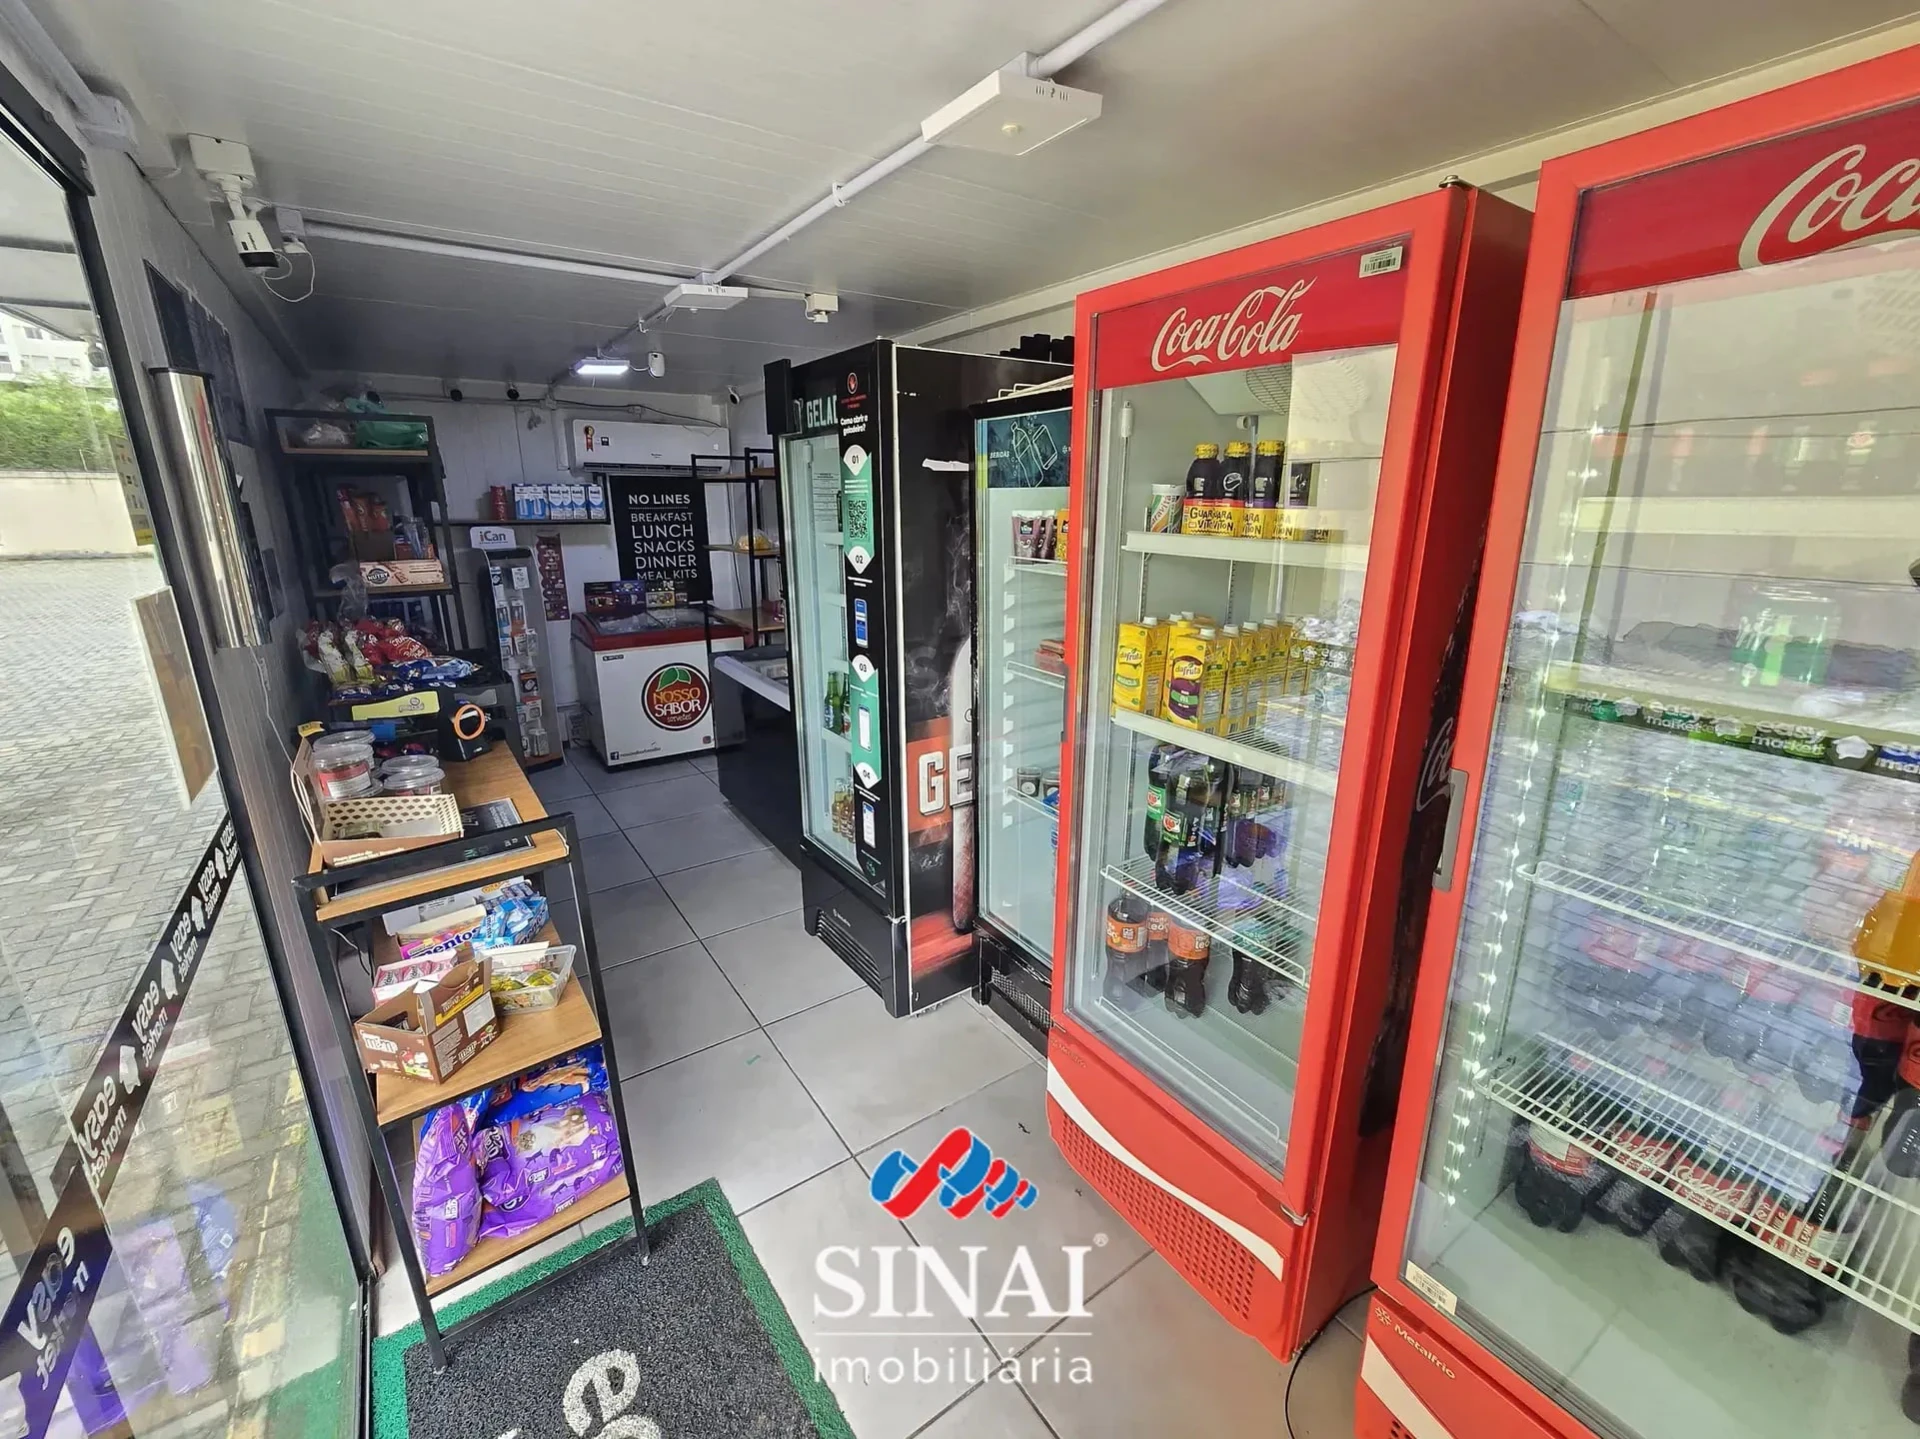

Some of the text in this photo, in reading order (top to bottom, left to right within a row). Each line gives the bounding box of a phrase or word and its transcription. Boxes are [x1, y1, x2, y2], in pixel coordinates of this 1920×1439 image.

[1152, 276, 1317, 372] Coca-Cola
[851, 455, 859, 464] 01
[628, 494, 691, 505] NO LINES
[631, 512, 693, 523] BREAKFAST
[479, 530, 506, 541] iCan
[632, 524, 694, 539] LUNCH
[634, 540, 695, 554] SNACKS
[635, 555, 697, 570] DINNER
[855, 554, 864, 564] 02
[367, 571, 389, 582] NUTRY
[637, 569, 698, 581] MEAL KITS
[859, 663, 867, 673] 03
[1175, 663, 1201, 677] dafruta
[653, 687, 701, 705] NOSSO
[655, 700, 702, 717] SABOR
[862, 769, 871, 780] 04
[1394, 1324, 1456, 1379] Metalfrio
